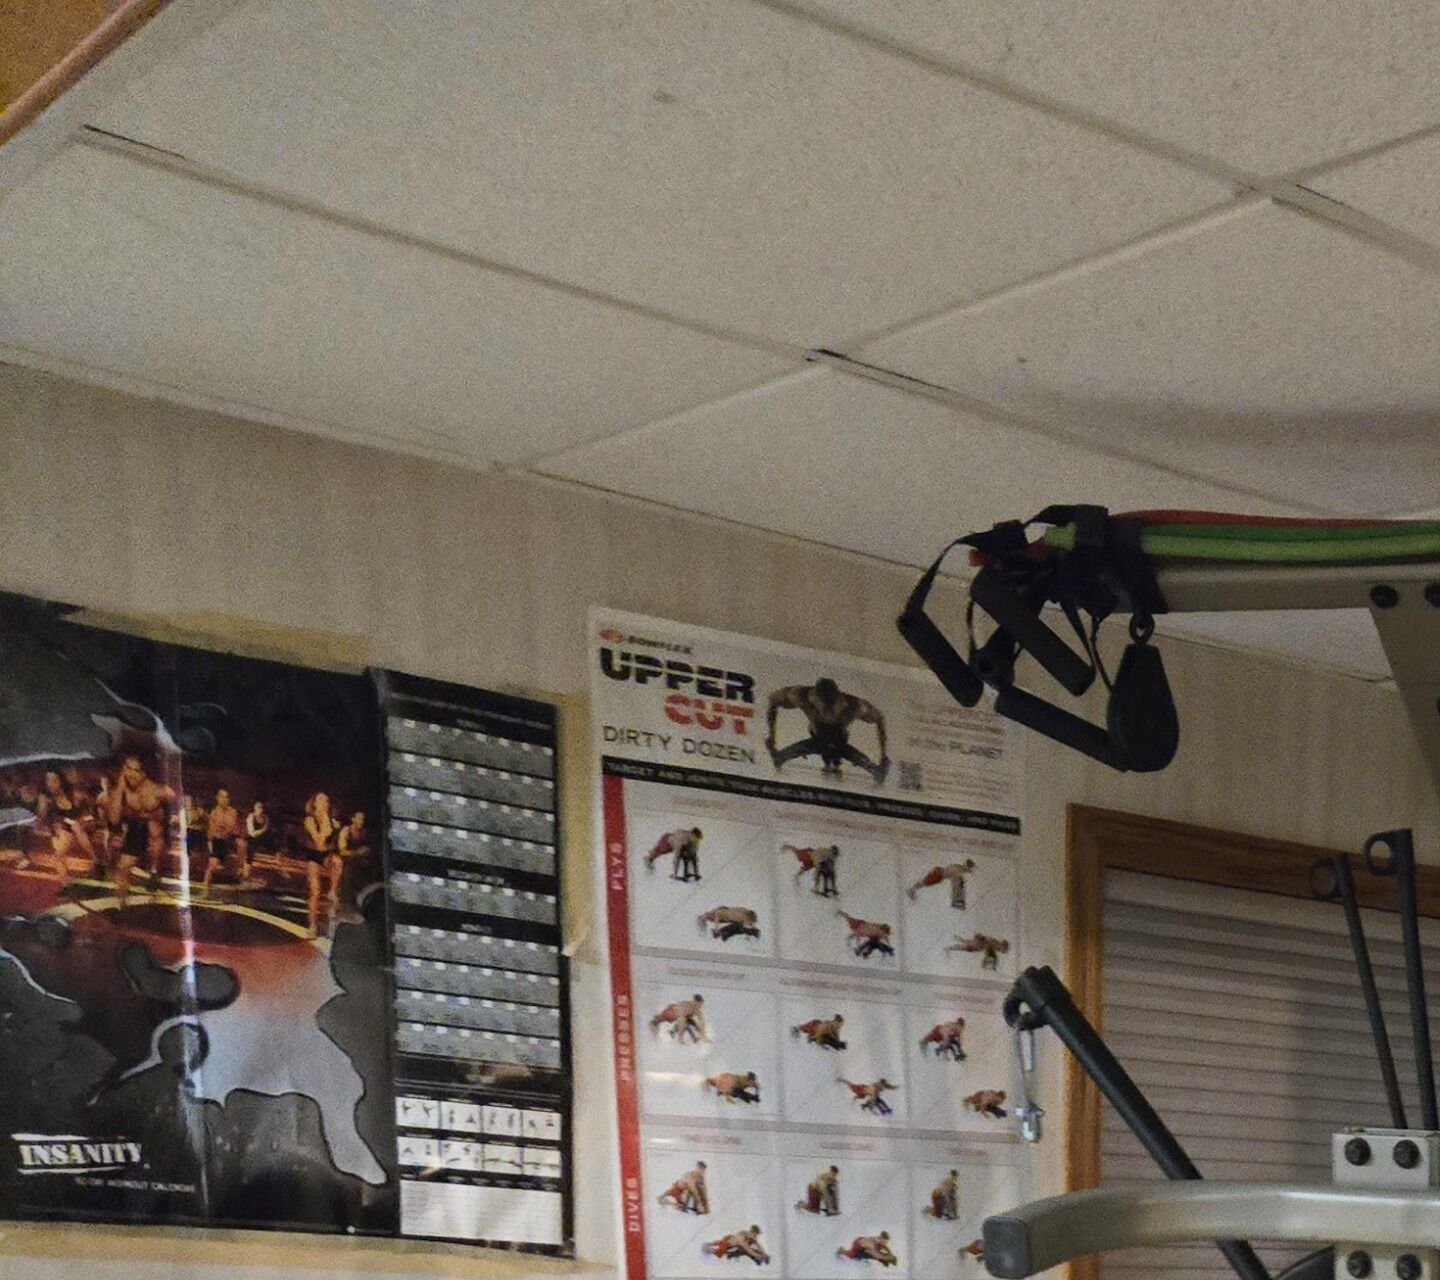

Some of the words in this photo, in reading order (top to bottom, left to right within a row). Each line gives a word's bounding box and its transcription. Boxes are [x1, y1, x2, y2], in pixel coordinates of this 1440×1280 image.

[600, 647, 755, 703] UPPER
[665, 694, 756, 735] CUT
[602, 725, 672, 751] DIRTY
[682, 737, 756, 765] DOZEN
[18, 1142, 142, 1165] INSANITY
[627, 1178, 640, 1232] DIVES
